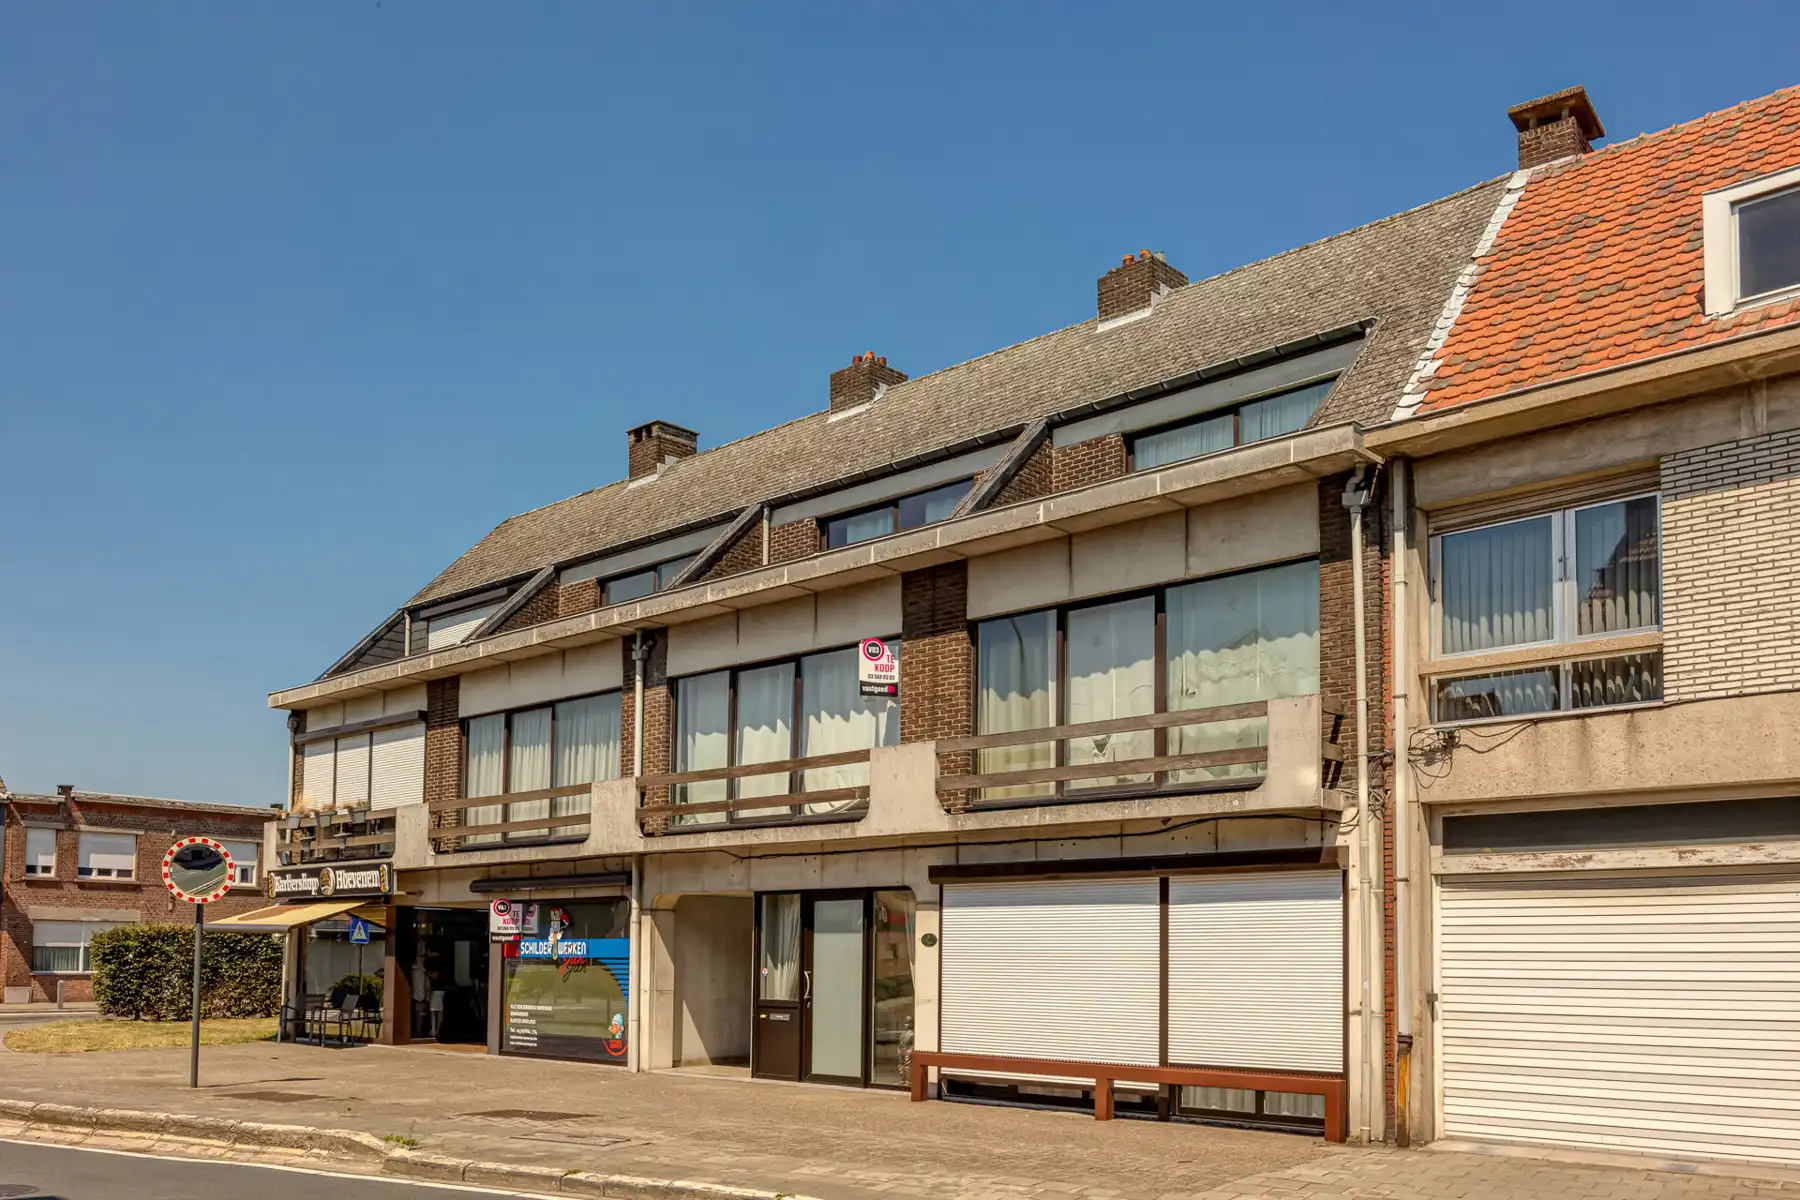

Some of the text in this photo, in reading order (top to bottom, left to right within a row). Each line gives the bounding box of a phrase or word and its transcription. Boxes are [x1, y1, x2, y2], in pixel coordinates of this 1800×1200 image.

[886, 654, 895, 663] TE
[874, 664, 896, 672] KOOP
[862, 685, 888, 694] vastgoed
[274, 869, 381, 895] Barbershop Hoevenen
[520, 941, 587, 955] SCHILDER WERKEN
